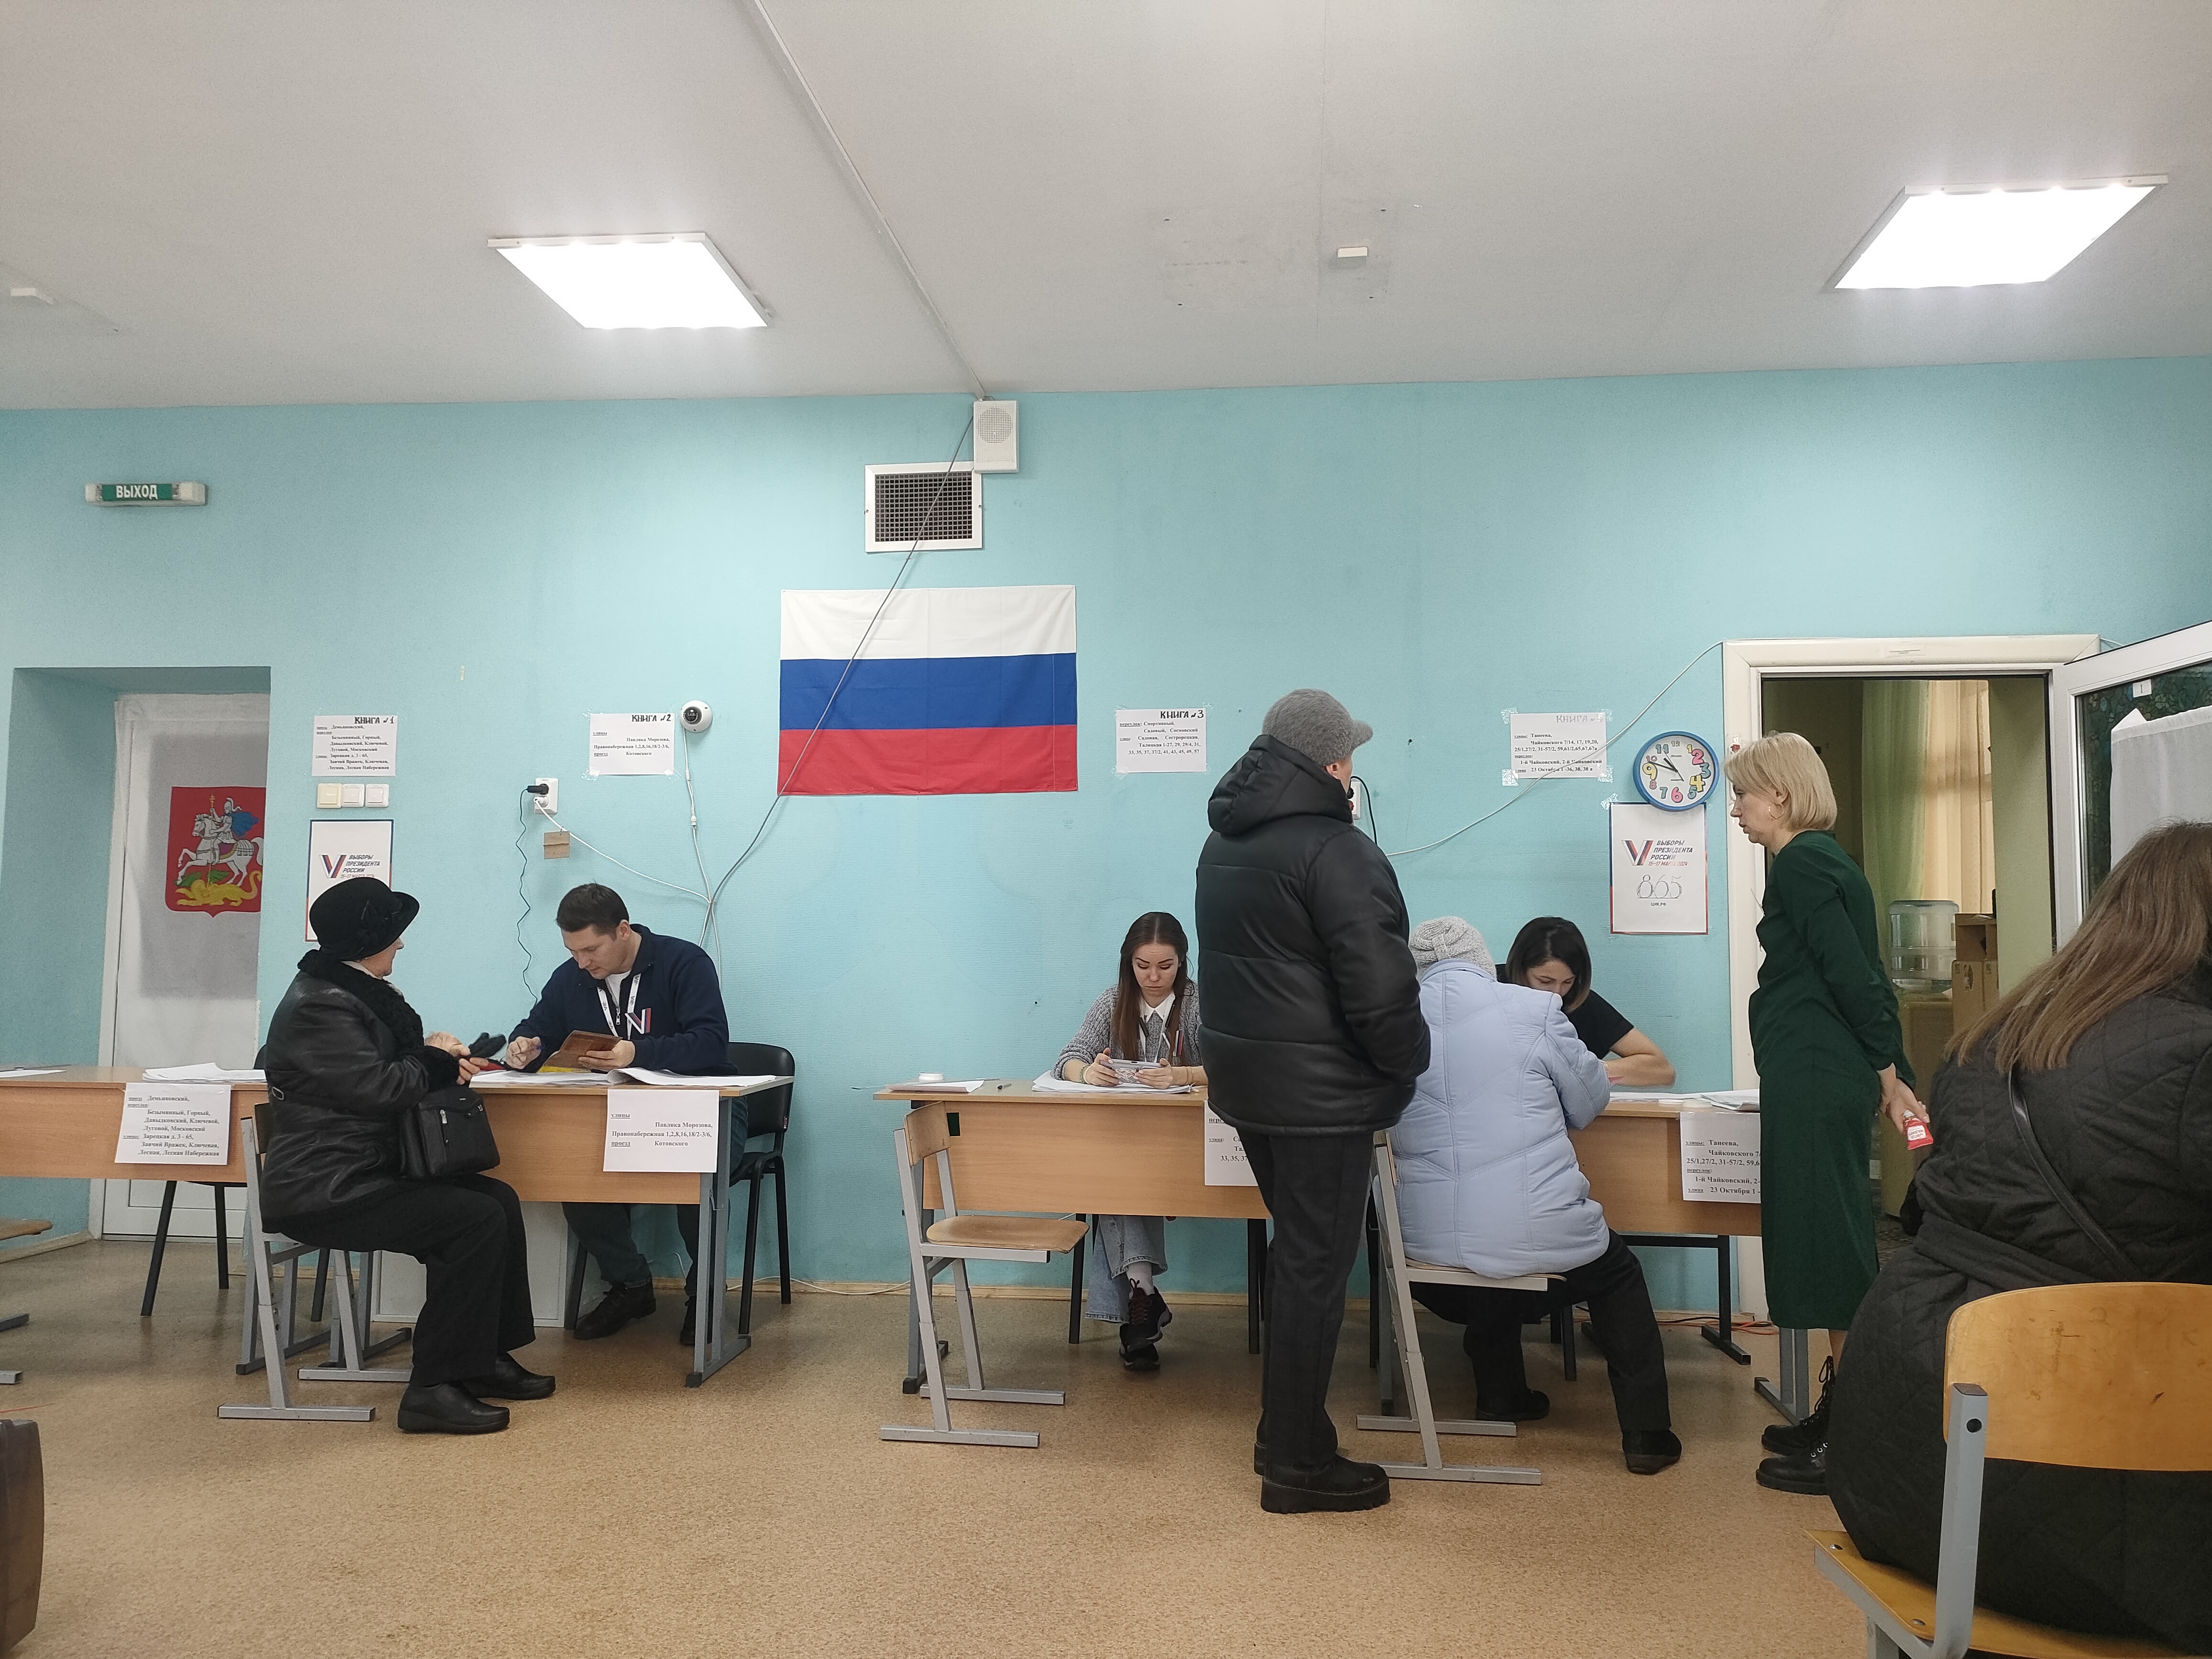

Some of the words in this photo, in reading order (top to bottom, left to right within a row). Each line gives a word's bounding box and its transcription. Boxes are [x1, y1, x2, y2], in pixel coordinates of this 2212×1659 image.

[116, 485, 158, 499] ВЫХОД
[1656, 744, 1669, 754] 11
[1687, 744, 1692, 753] 1
[1692, 749, 1704, 765] 2
[1642, 763, 1658, 781] 9
[1700, 763, 1711, 779] 3
[1649, 780, 1657, 790] 8
[1690, 774, 1705, 792] 4
[1659, 786, 1668, 799] 7
[1671, 786, 1683, 803] 6
[1688, 786, 1697, 799] 5
[1637, 874, 1682, 898] 865
